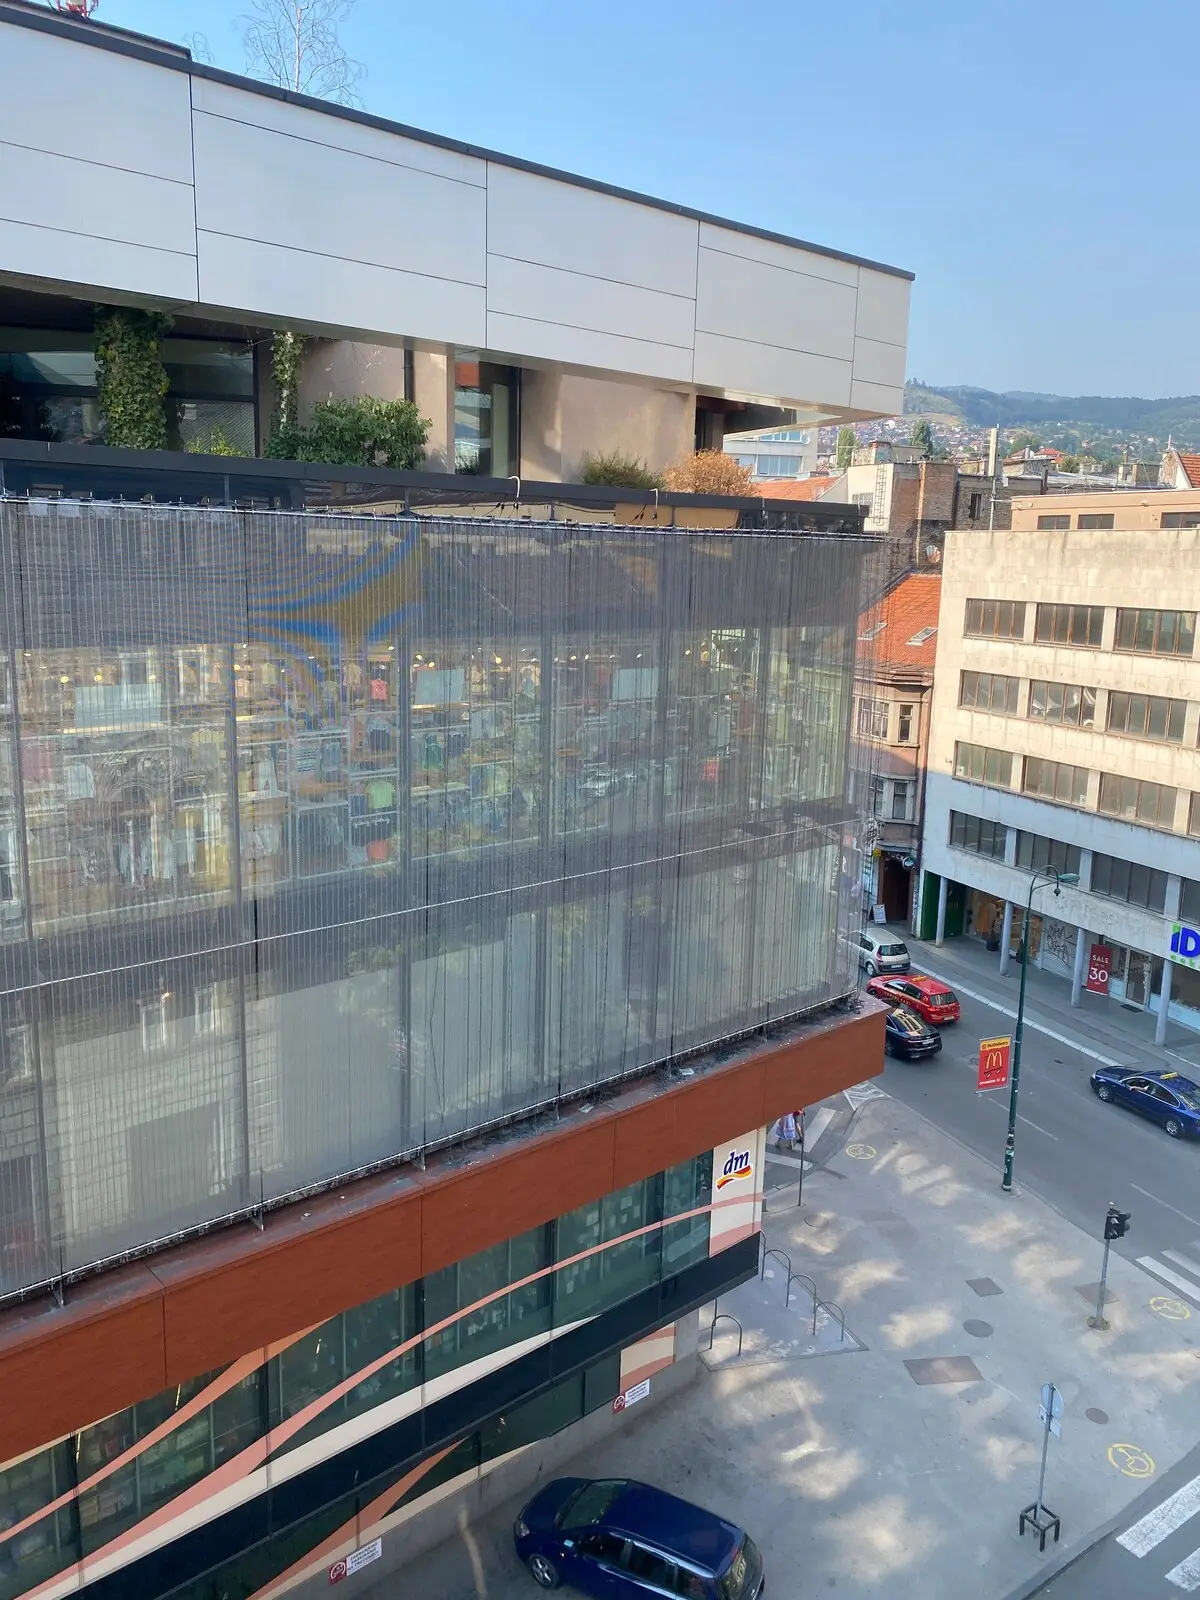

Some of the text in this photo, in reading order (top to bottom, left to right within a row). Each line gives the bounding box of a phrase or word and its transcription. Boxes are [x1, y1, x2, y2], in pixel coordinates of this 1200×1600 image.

[1092, 954, 1109, 964] SALE
[1089, 967, 1108, 983] 30
[723, 1151, 749, 1176] dm
